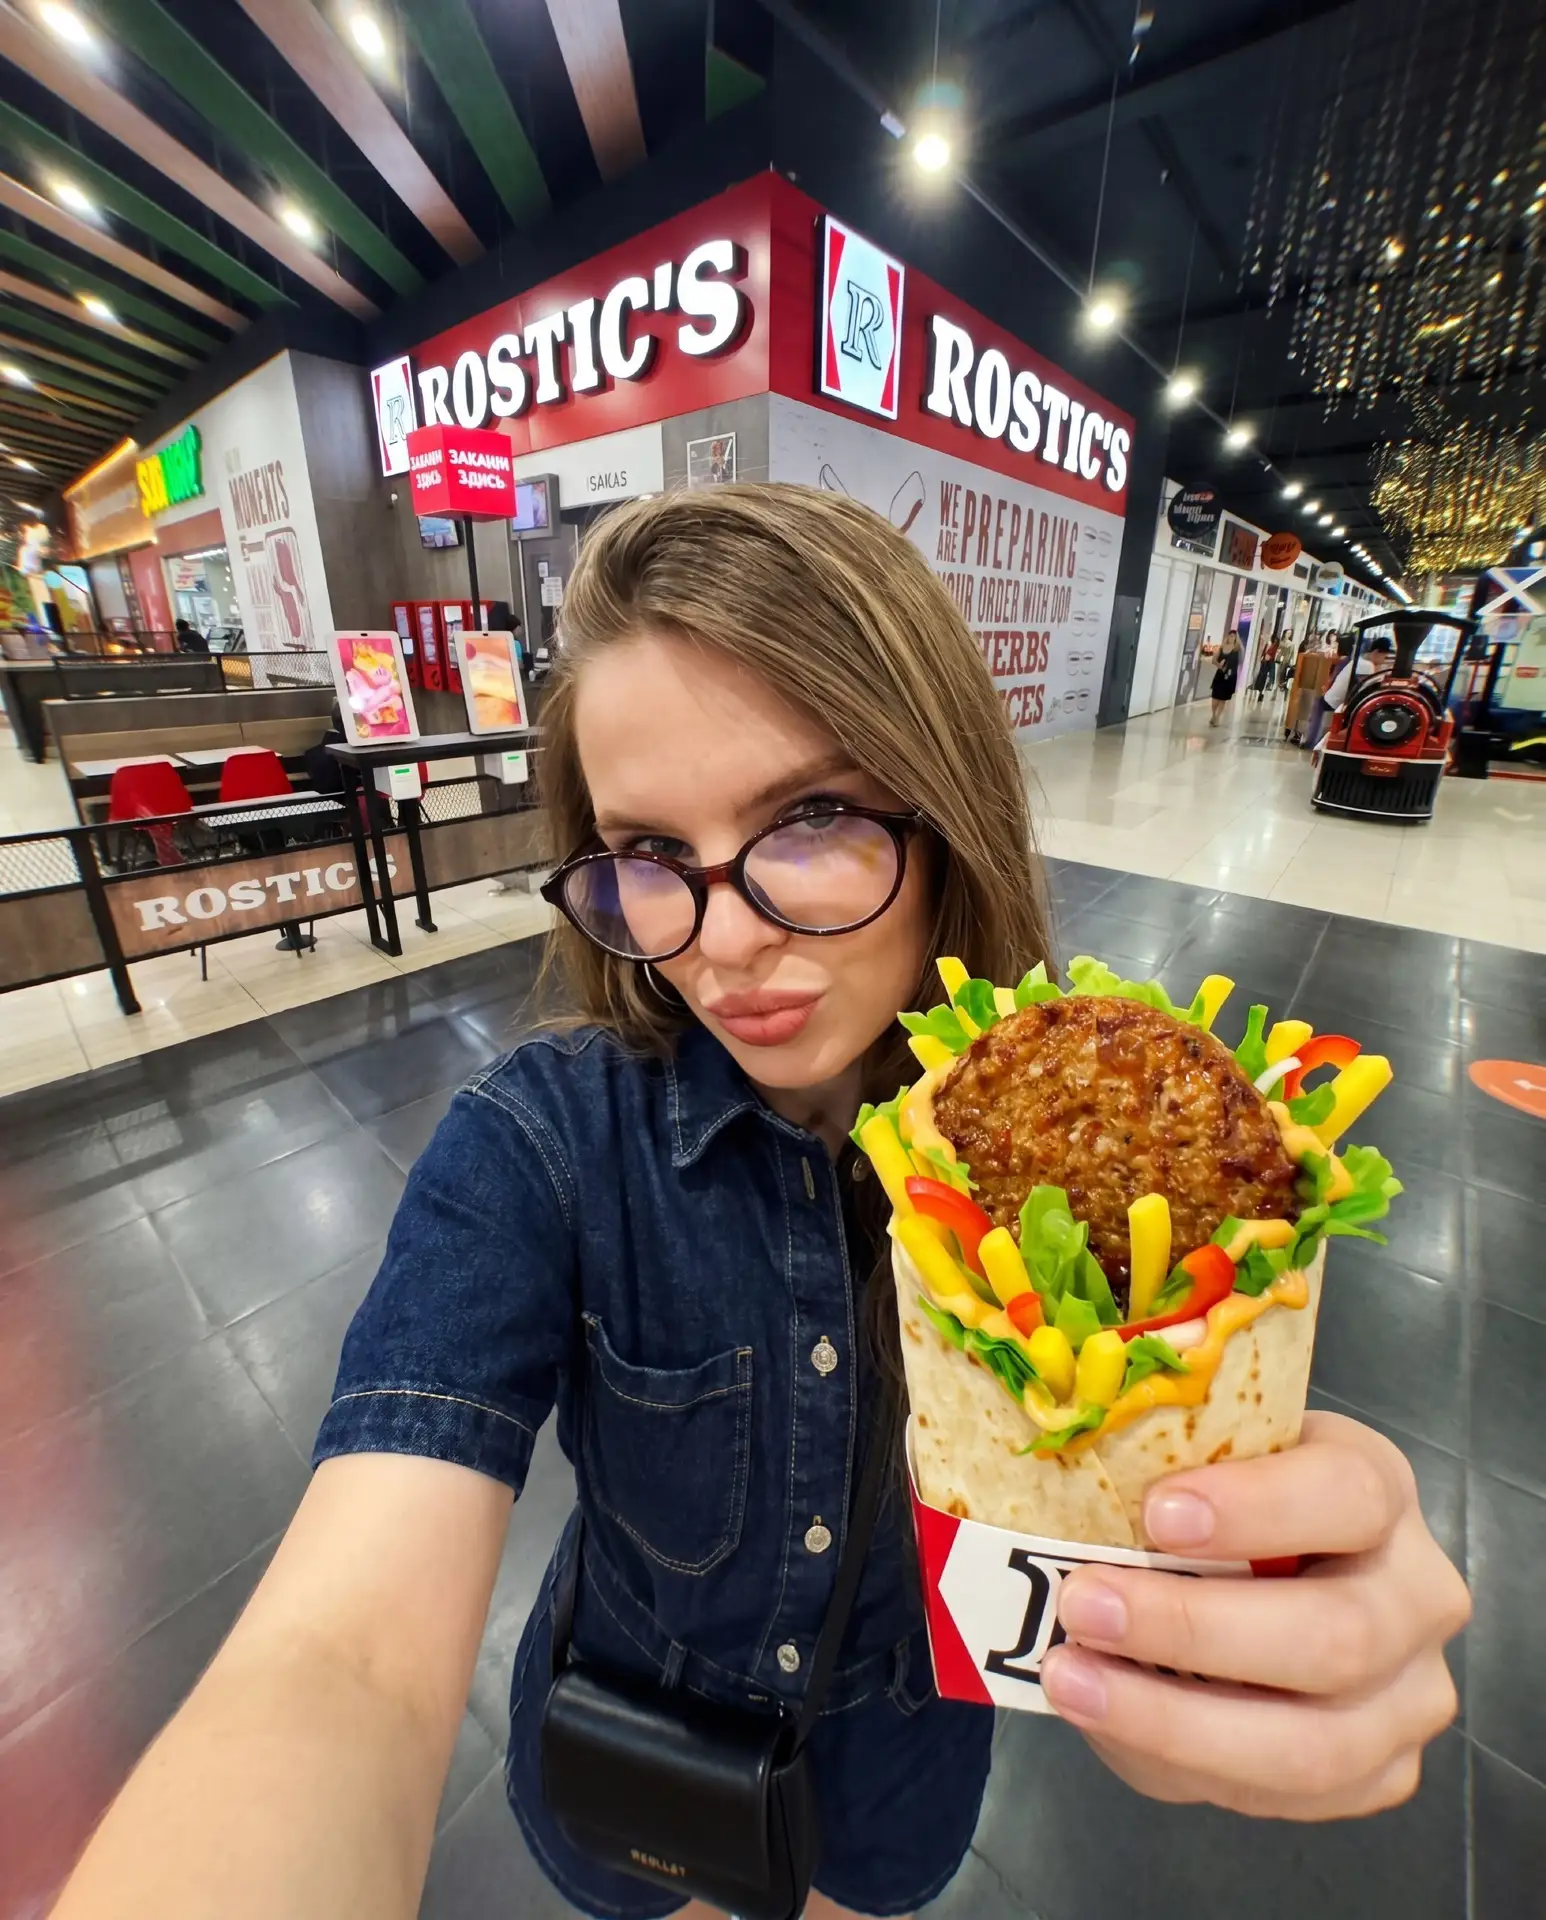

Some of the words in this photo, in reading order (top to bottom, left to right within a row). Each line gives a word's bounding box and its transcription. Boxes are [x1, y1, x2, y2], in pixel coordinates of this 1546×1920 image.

[418, 240, 740, 429] ROSTIC'S
[841, 279, 884, 371] R
[927, 314, 1131, 492] ROSTIC'S
[936, 529, 958, 563] ARE
[940, 480, 962, 529] WE
[960, 489, 1078, 579] PREPARING
[977, 576, 1020, 624] ORDER
[1022, 581, 1050, 624] WITH
